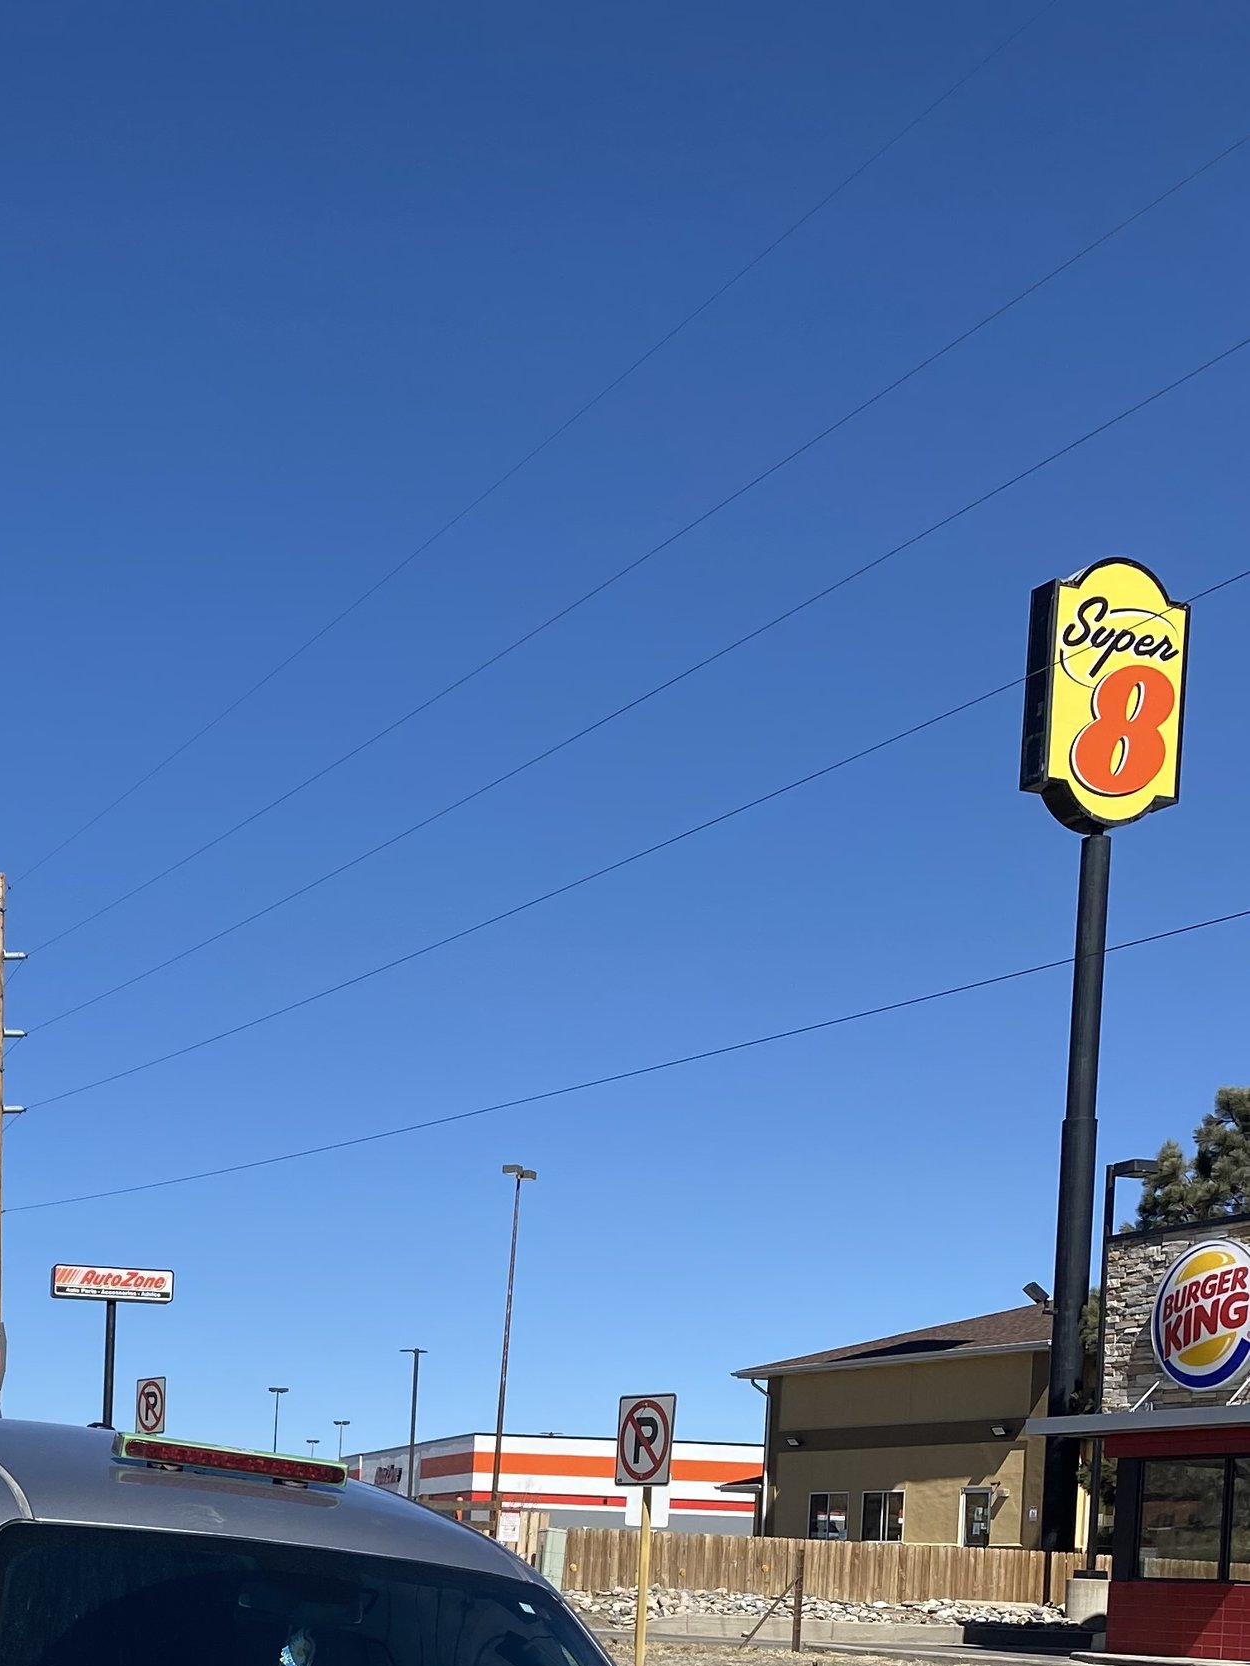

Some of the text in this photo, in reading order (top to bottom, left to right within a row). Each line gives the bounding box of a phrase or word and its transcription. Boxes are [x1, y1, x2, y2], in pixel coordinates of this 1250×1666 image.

[1062, 596, 1179, 678] Super
[1069, 665, 1175, 797] 8
[80, 1269, 166, 1290] AutoZone
[1163, 1266, 1249, 1322] BURGER
[1164, 1291, 1250, 1359] KING
